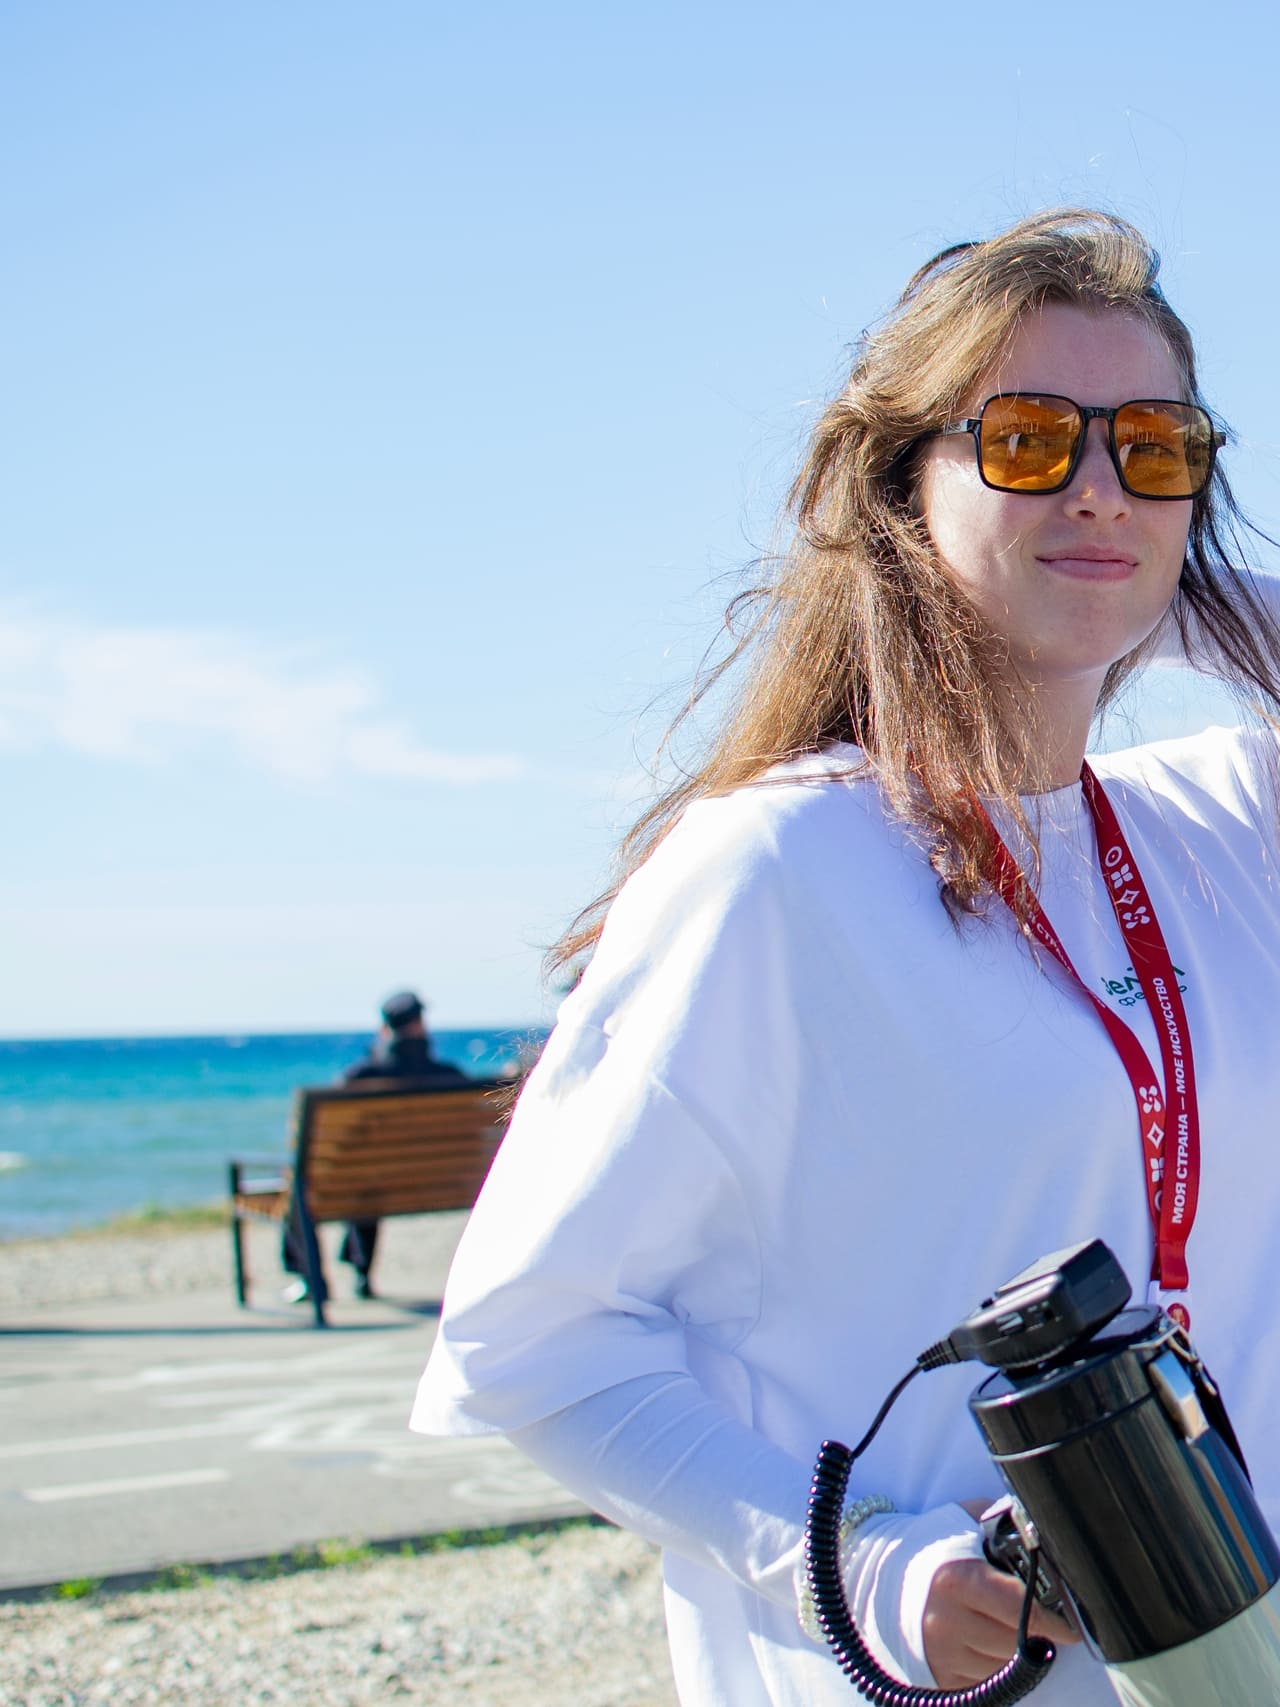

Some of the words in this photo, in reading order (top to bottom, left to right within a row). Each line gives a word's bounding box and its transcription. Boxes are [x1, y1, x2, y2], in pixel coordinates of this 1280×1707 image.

[1152, 977, 1183, 1056] ИСКУССТВО
[1174, 1057, 1186, 1094] МОЕ
[1177, 1114, 1188, 1179] СТРАНА
[1172, 1182, 1187, 1224] МОЯ
